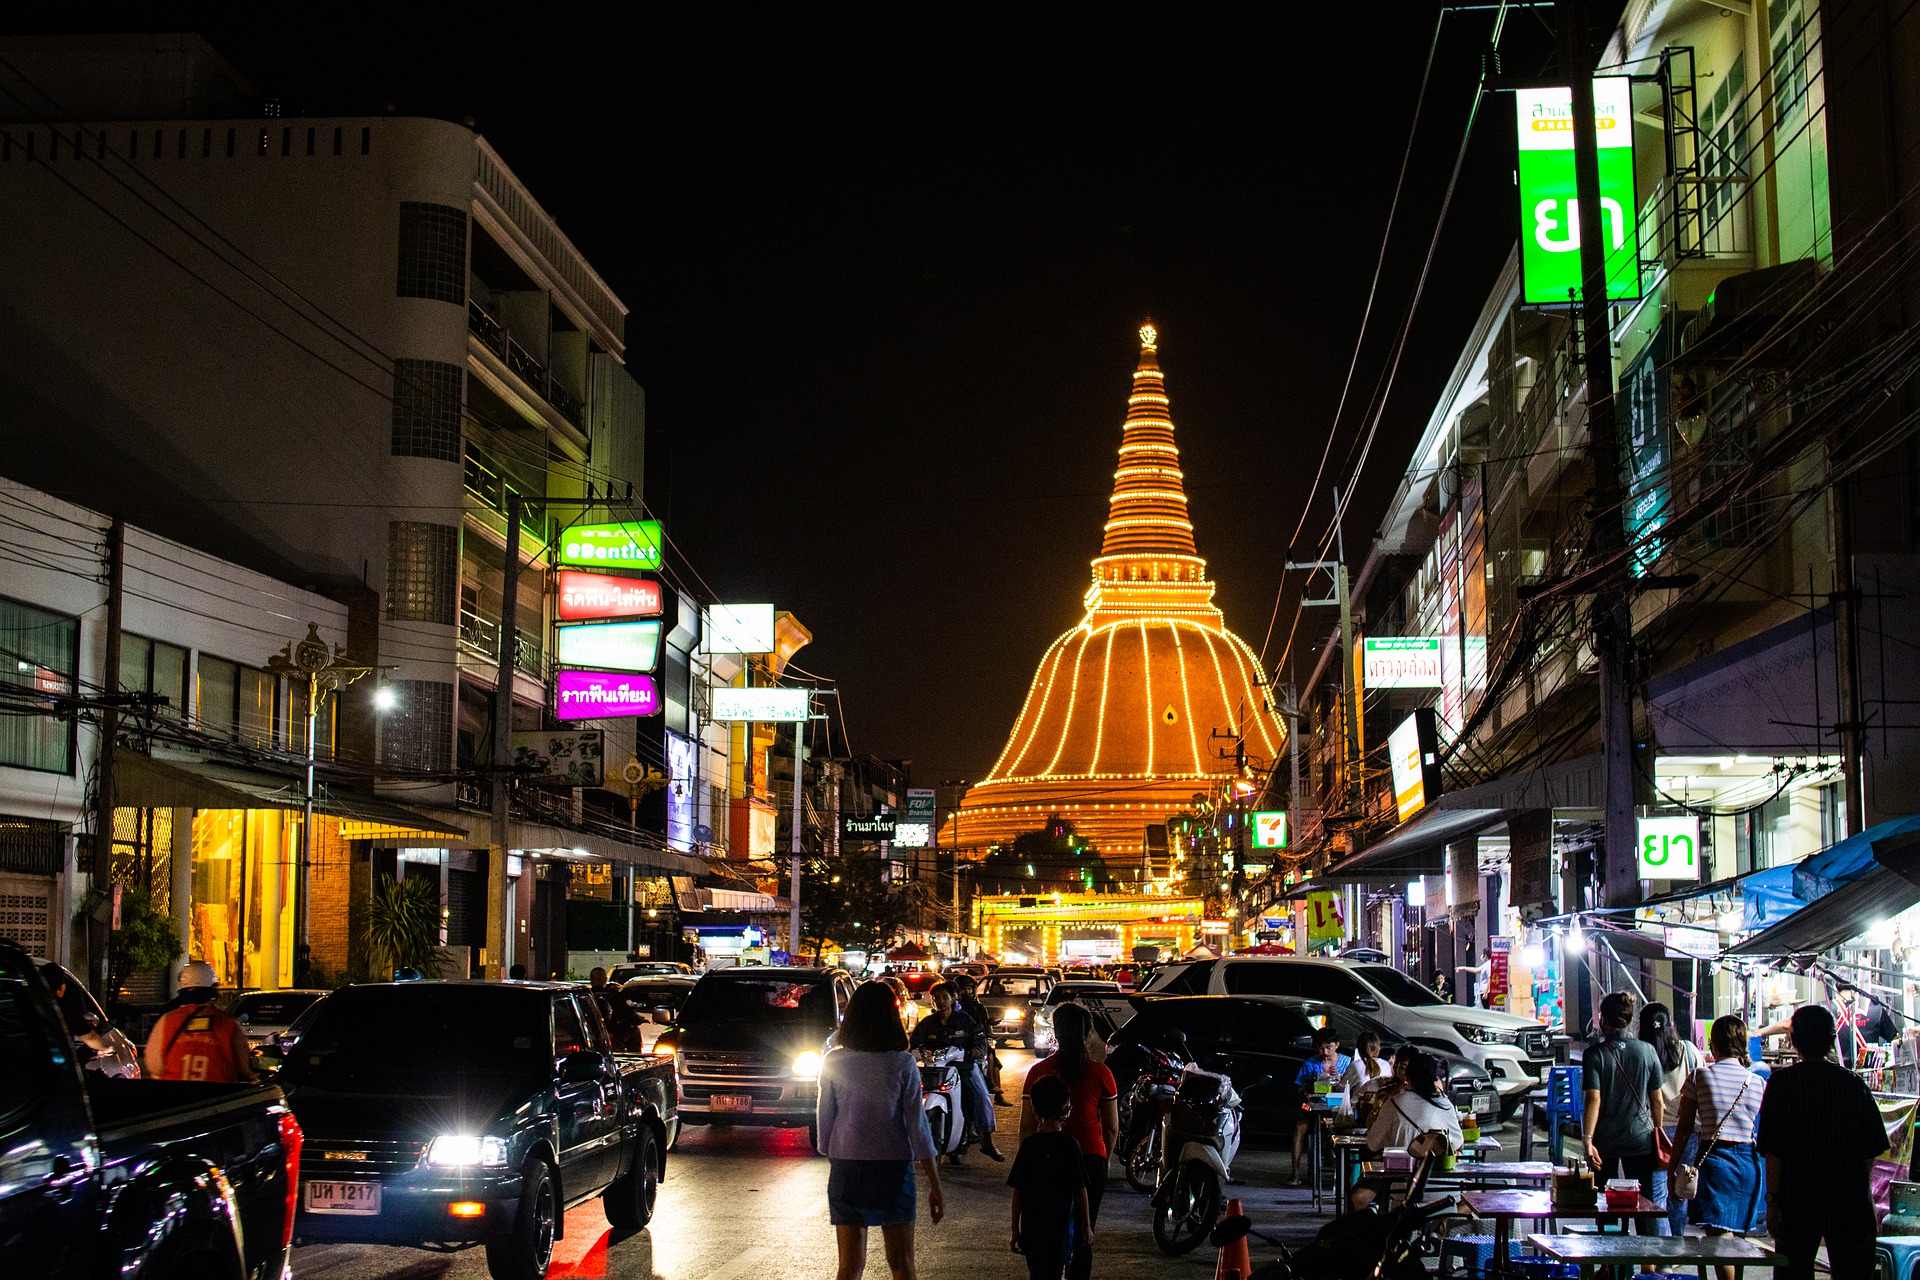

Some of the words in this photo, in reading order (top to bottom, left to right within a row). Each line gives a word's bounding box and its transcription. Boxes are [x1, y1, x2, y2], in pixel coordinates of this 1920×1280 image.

[1534, 196, 1625, 253] ยา
[566, 541, 657, 560] @Dentist
[561, 683, 651, 704] รากฟันเทียม
[845, 815, 895, 832] ร้านมาโนช
[1643, 834, 1694, 866] ยา
[181, 1054, 210, 1080] 19
[340, 1185, 374, 1200] 1217
